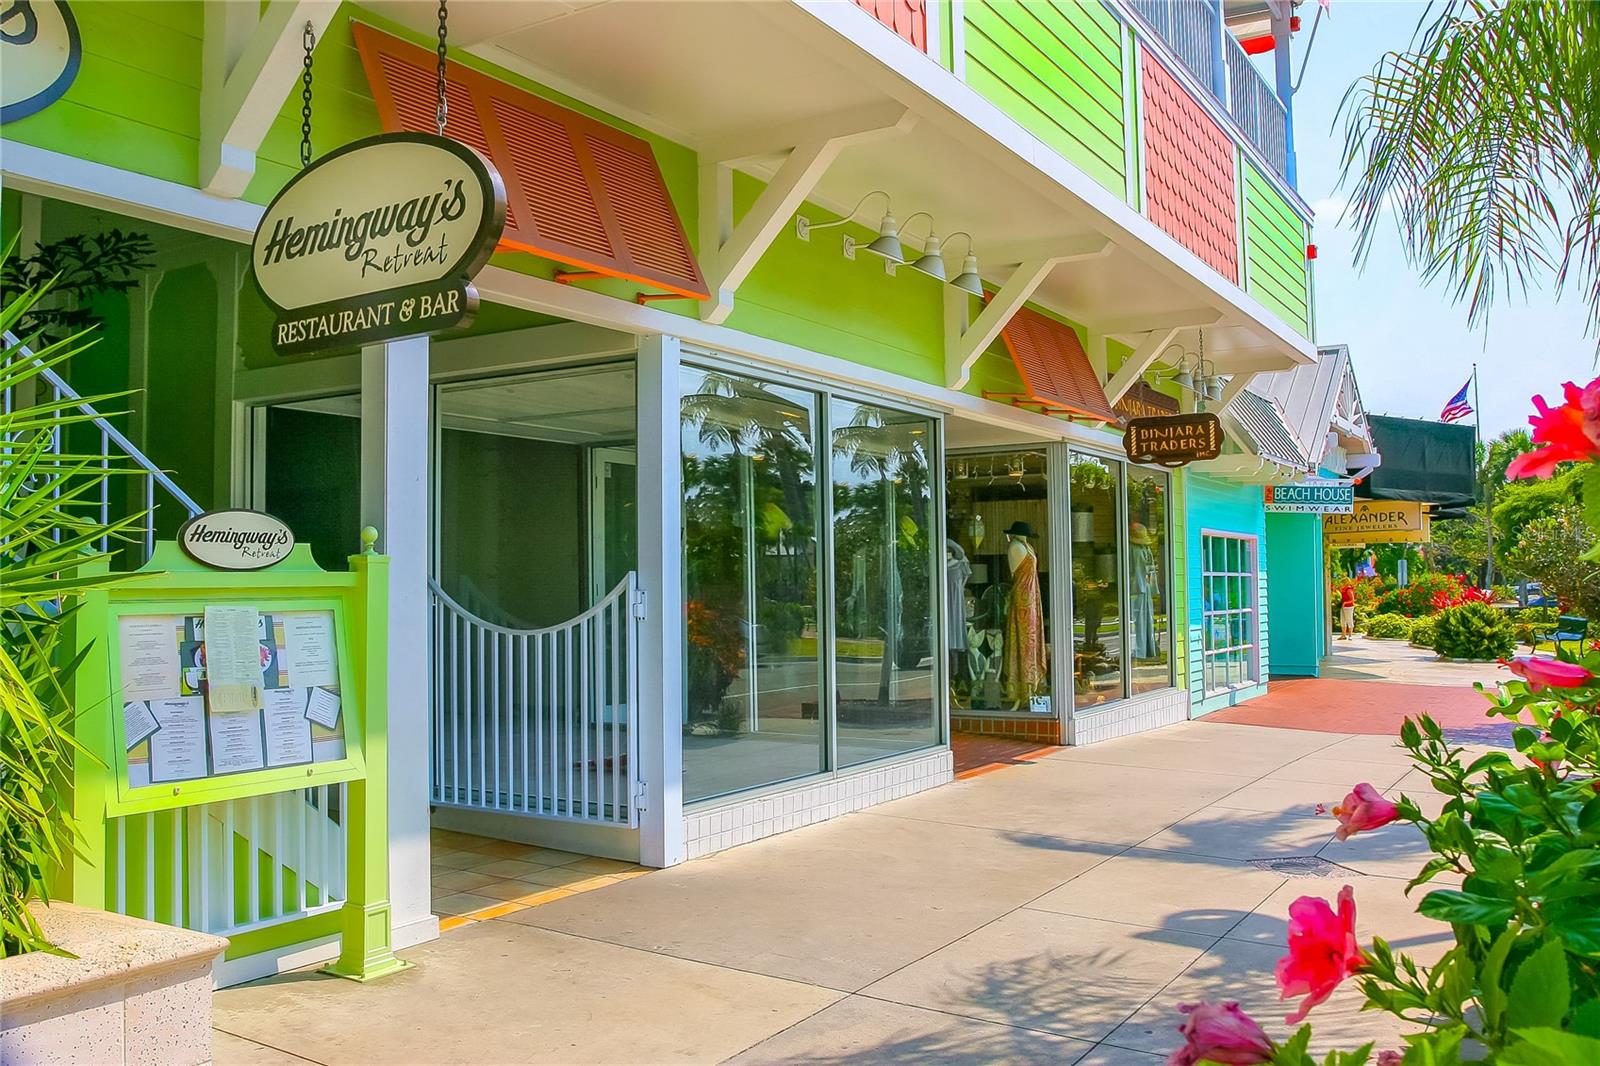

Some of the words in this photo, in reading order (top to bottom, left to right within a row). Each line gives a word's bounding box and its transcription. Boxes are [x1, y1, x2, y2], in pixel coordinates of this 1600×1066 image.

[263, 178, 466, 266] Hemingway's
[361, 232, 448, 279] Retreat
[276, 302, 395, 345] RESTAURANT
[399, 298, 416, 323] &
[420, 289, 460, 320] BAR
[1140, 438, 1206, 453] TRADERS
[1274, 487, 1311, 501] BEACH
[1314, 487, 1351, 501] HOUSE
[1324, 511, 1408, 529] ALEXANDER
[188, 524, 288, 550] Hemingway's
[241, 546, 281, 559] Retreat
